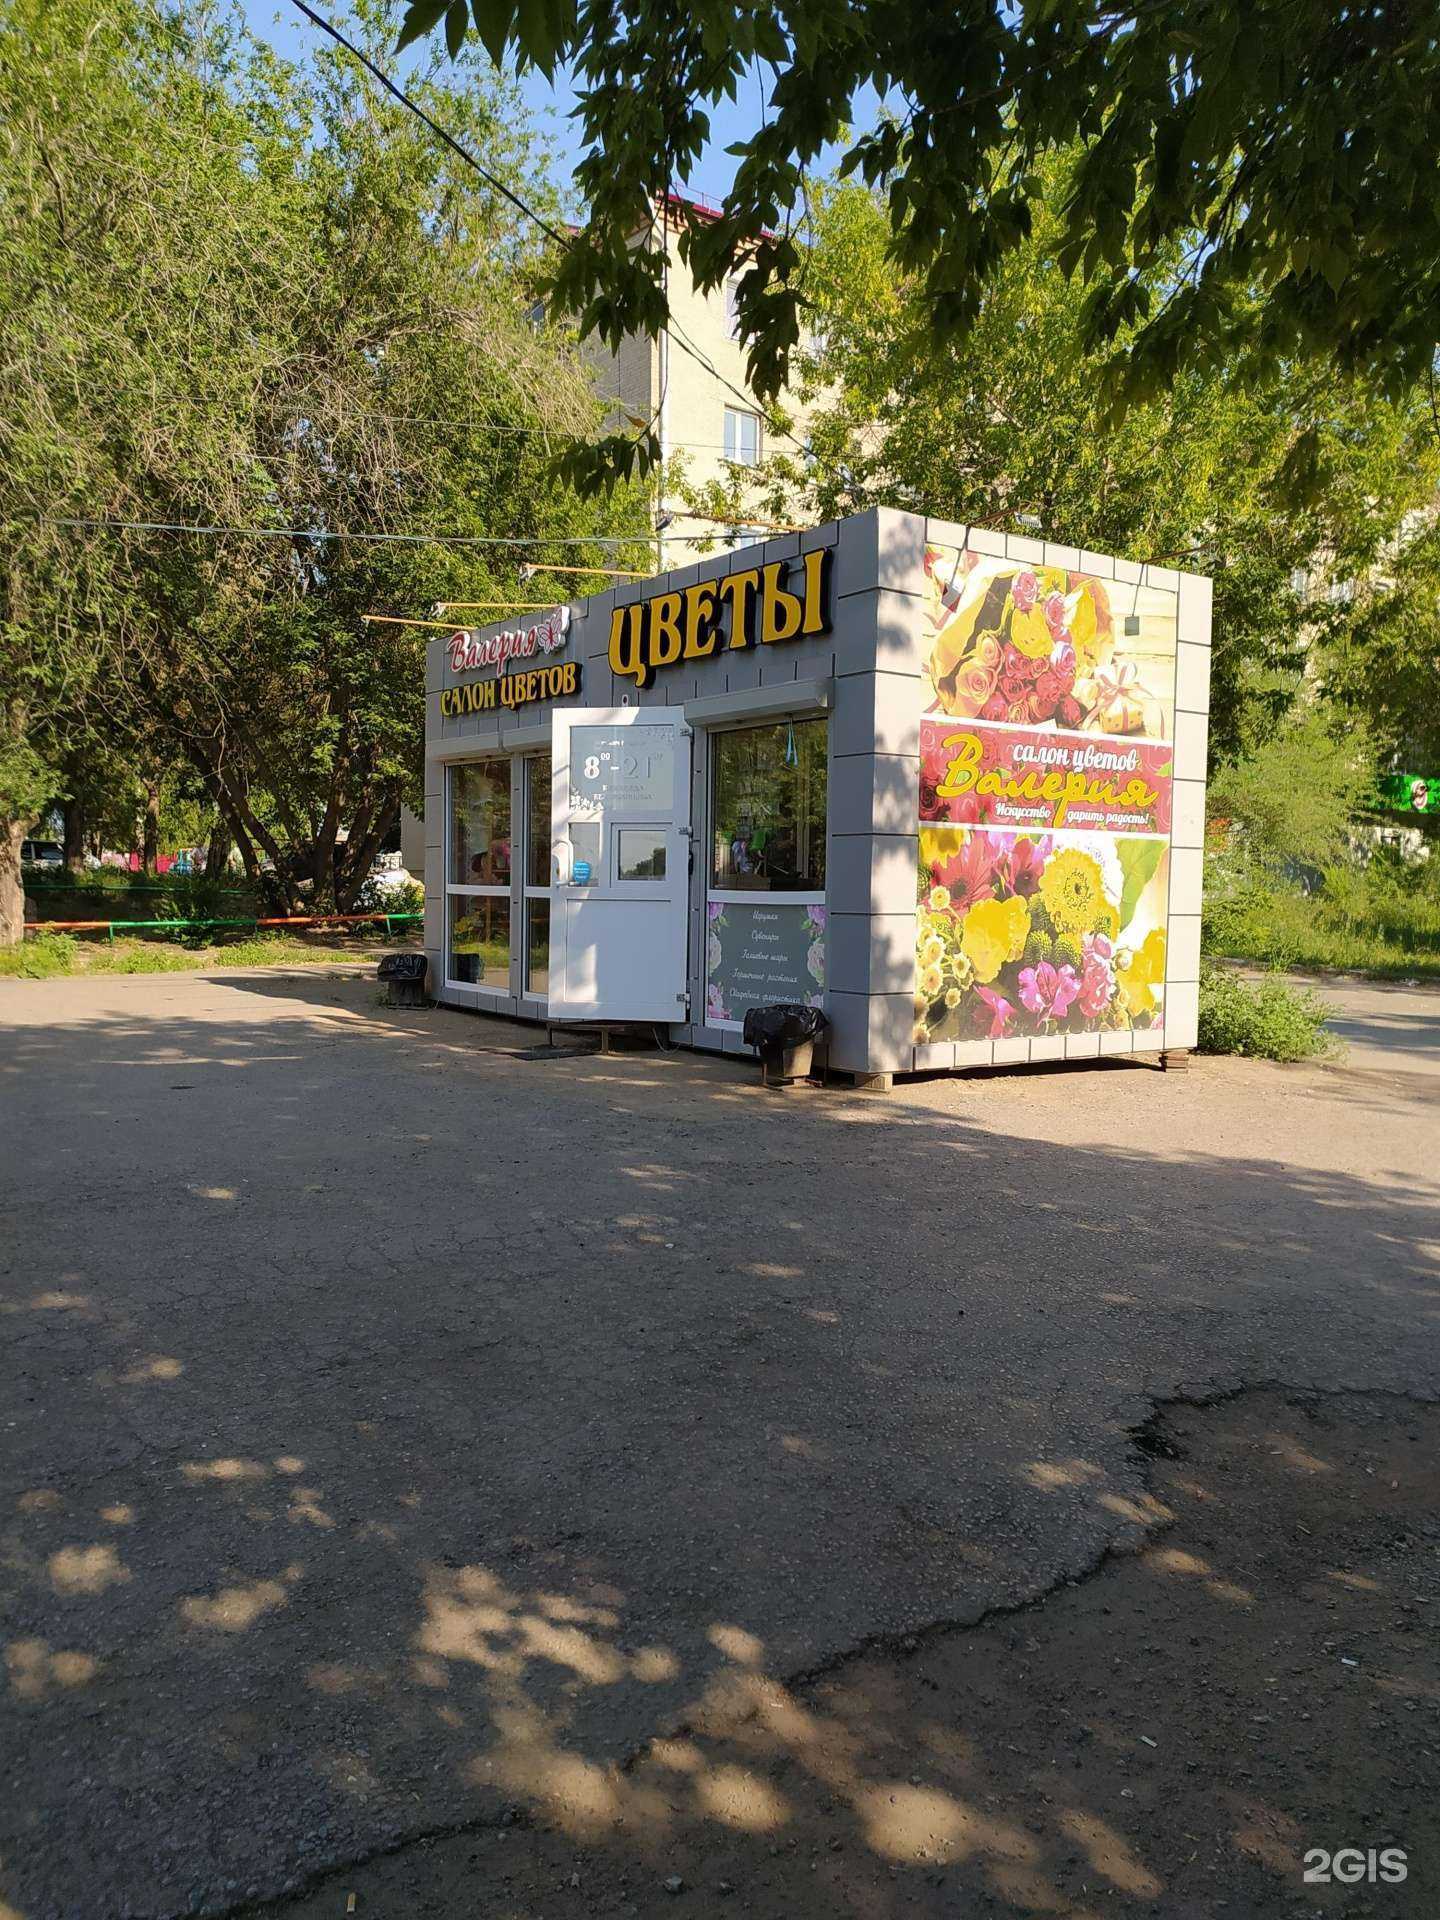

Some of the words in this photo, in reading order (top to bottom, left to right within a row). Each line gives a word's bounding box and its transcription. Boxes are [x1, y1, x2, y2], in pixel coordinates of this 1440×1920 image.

[608, 549, 829, 688] ЦВЕТЫ
[446, 626, 538, 677] Валерия
[441, 678, 497, 716] САЛОН
[500, 662, 578, 710] ЦВЕТОВ
[936, 733, 1159, 829] Валерия
[1013, 743, 1069, 766] салон
[1073, 745, 1138, 773] цветов
[995, 802, 1051, 820] Искусство
[1067, 810, 1104, 824] дарить
[1106, 812, 1149, 825] радость!
